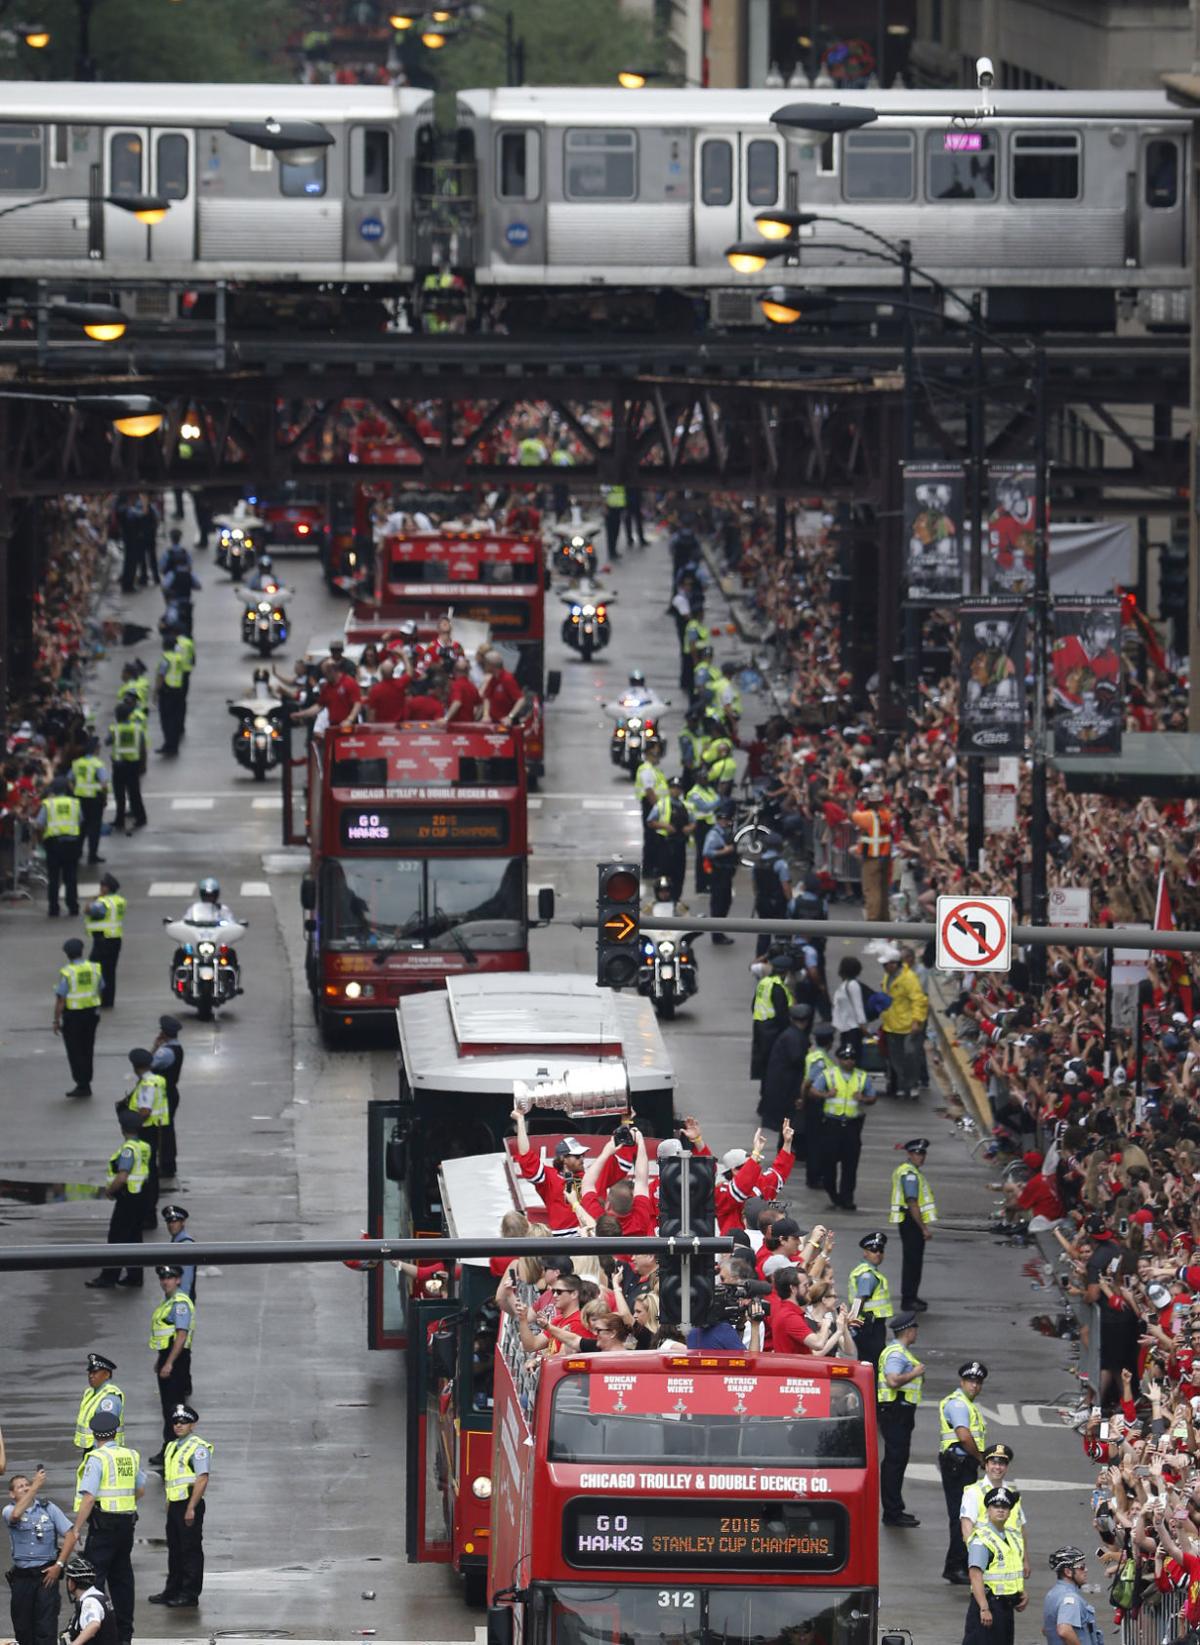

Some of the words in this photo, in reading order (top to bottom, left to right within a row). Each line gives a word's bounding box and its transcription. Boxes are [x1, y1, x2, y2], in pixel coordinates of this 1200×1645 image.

[358, 814, 380, 827] GO
[348, 826, 389, 839] HAWKS
[603, 1375, 637, 1384] DUNCAN
[667, 1378, 694, 1386] ROCKY
[723, 1376, 758, 1385] PATRICK
[786, 1378, 815, 1387] BRENT
[727, 1384, 754, 1392] SHARP
[117, 1466, 134, 1477] POLICE
[579, 1472, 636, 1489] CHICAGO
[639, 1472, 692, 1489] TROLLEY
[695, 1473, 706, 1489] &
[708, 1474, 757, 1490] DOUBLE
[760, 1475, 807, 1492] DECKER
[810, 1477, 832, 1493] CO.
[596, 1515, 628, 1532] GO
[720, 1518, 760, 1533] 2015
[578, 1534, 644, 1552] HAWKS
[652, 1535, 716, 1553] STANLEY
[719, 1536, 747, 1553] CUP
[751, 1536, 830, 1554] CHAMPIONS
[657, 1591, 695, 1608] 312
